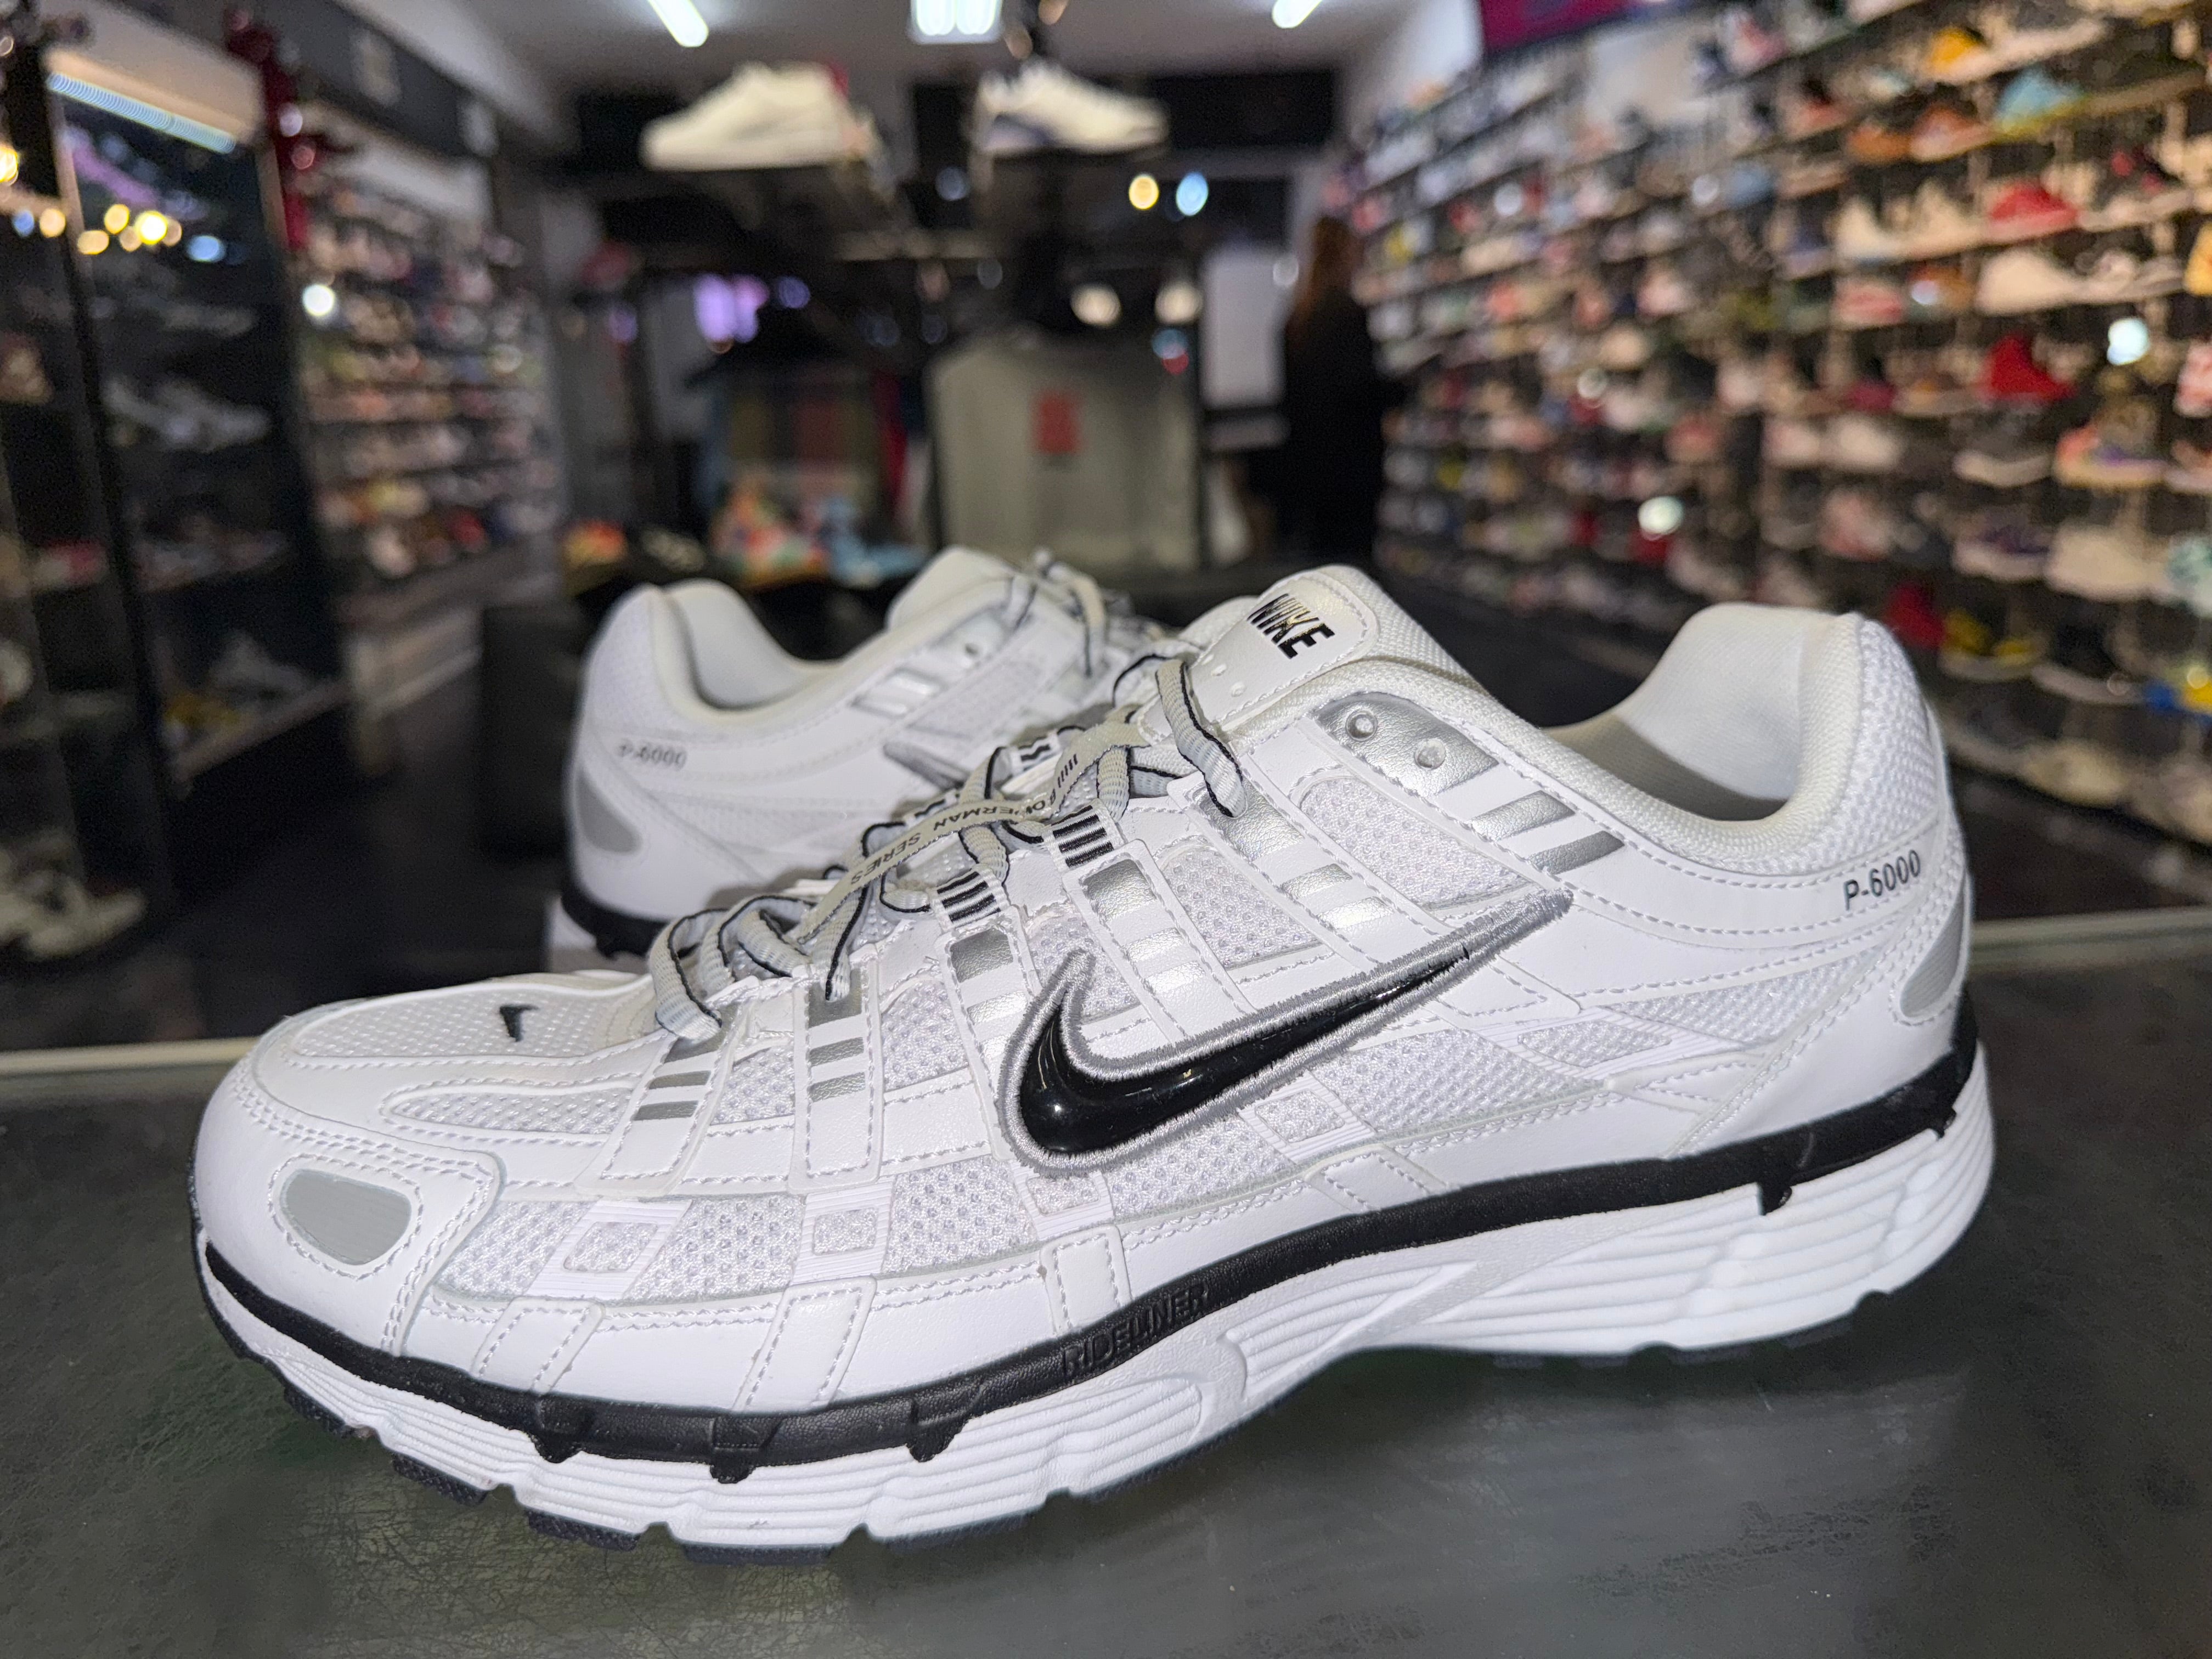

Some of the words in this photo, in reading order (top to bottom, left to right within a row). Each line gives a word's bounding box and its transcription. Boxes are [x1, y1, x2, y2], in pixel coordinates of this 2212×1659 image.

[1247, 593, 1335, 659] NIKE
[851, 832, 922, 884] SERIES
[1843, 849, 1921, 911] P-6000
[1063, 1284, 1209, 1376] RIDELINER
